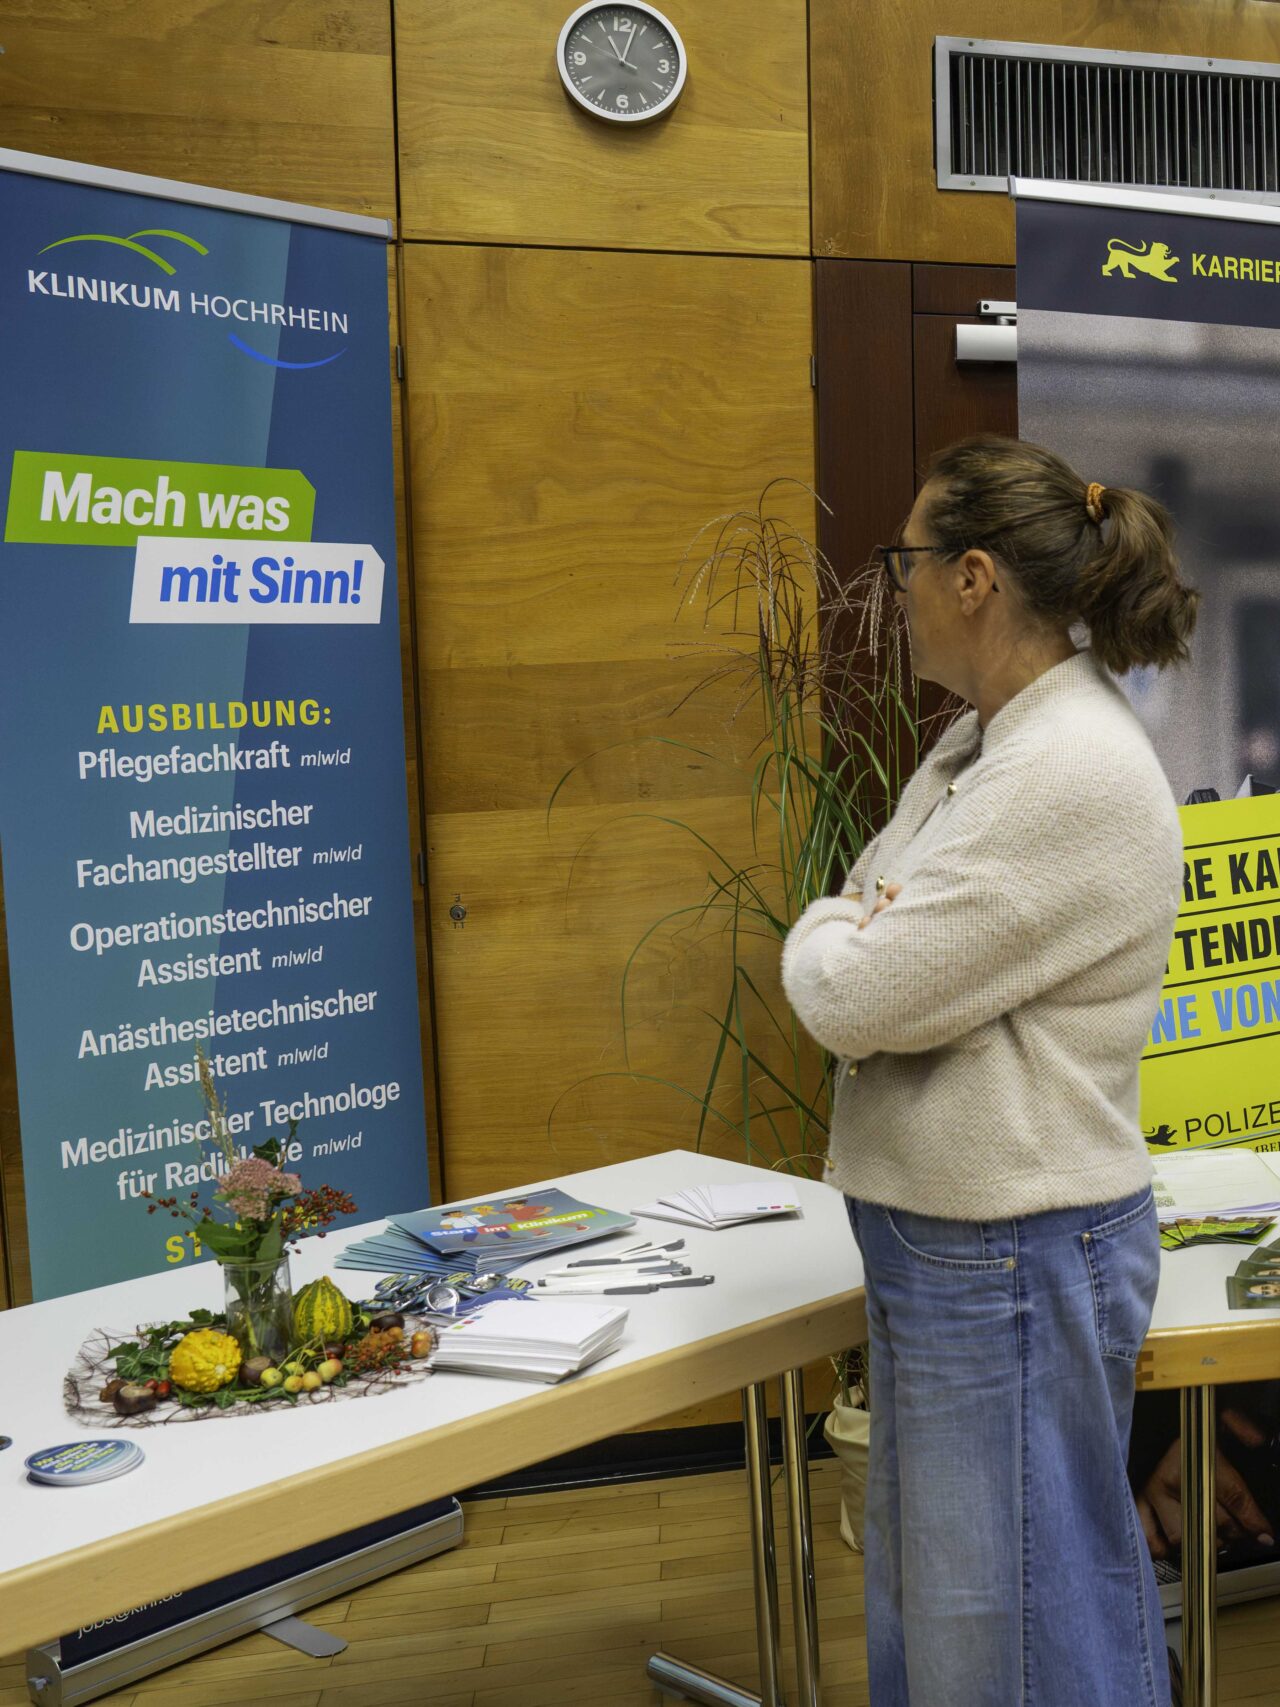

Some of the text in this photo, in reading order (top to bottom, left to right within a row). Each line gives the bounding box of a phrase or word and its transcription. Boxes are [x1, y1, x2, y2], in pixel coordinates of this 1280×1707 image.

[614, 16, 632, 32] 12
[574, 52, 587, 66] 9
[656, 60, 670, 74] 3
[616, 94, 628, 108] 6
[28, 269, 348, 333] KLINIKUM HOCHRHEIN
[40, 470, 290, 532] Mach was
[160, 554, 364, 605] mit Sinn!
[97, 699, 332, 734] AUSBILDUNG:
[78, 741, 290, 783] Pflegefachkraft
[130, 799, 313, 839] Medizinischer
[76, 843, 302, 888] Fachangestellter
[70, 893, 372, 956] Operationstechnischer
[138, 947, 261, 988] Assistent
[78, 987, 377, 1059] Anästhesietechnischer
[1150, 994, 1201, 1045] NE
[144, 1046, 268, 1091] Assistent
[60, 1079, 400, 1169] Medizinischer Technologe
[117, 1170, 157, 1201] für
[517, 1212, 589, 1229] Klinikum
